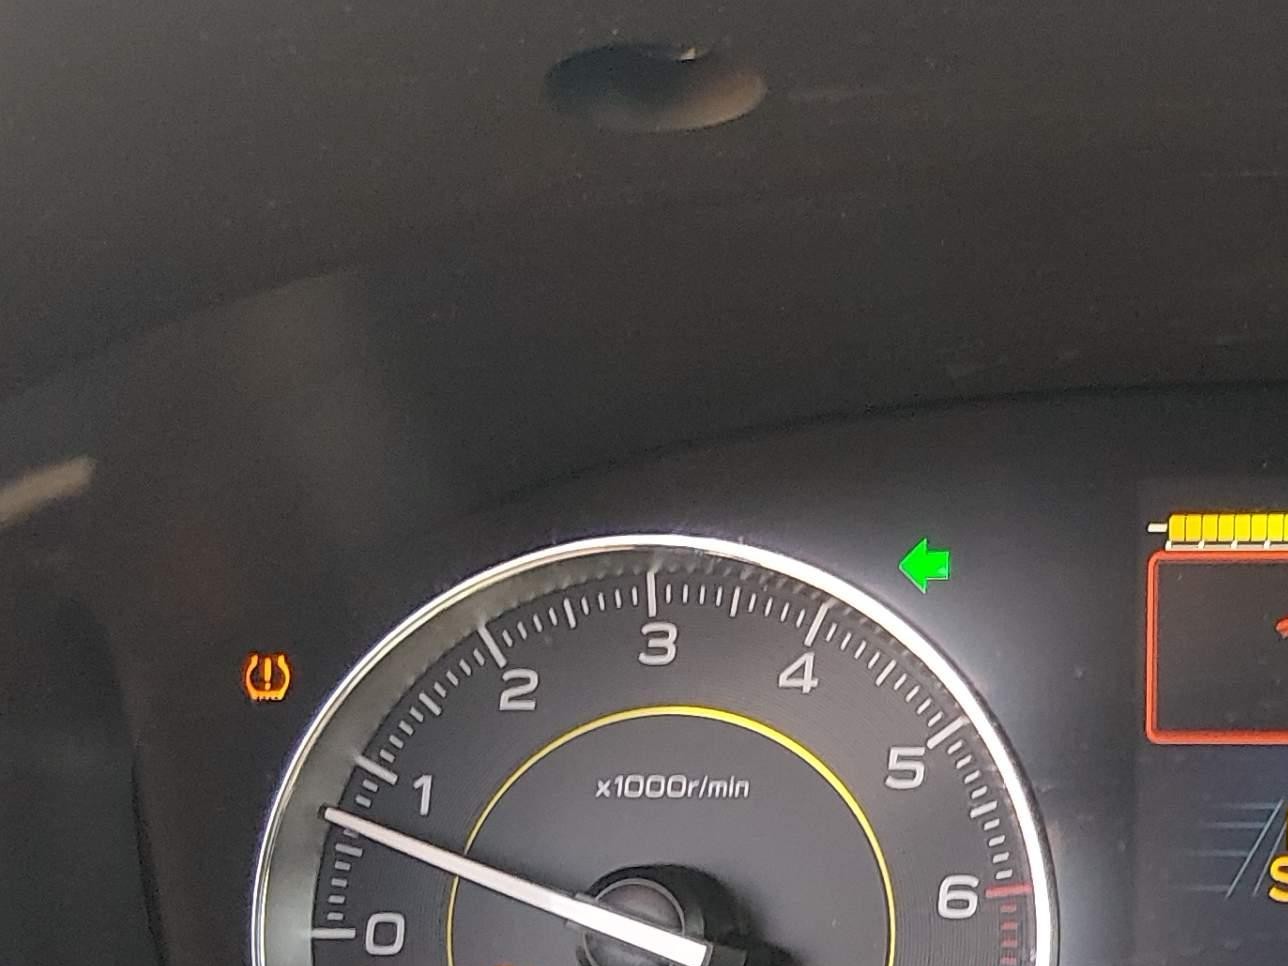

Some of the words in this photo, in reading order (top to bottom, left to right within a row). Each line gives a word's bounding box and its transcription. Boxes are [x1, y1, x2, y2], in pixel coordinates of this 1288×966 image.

[639, 622, 678, 665] 3
[498, 669, 539, 711] 2
[778, 653, 819, 694] 4
[595, 774, 750, 800] x1000r/min
[885, 746, 926, 789] 5
[412, 774, 432, 815] 1
[937, 875, 980, 919] 6
[365, 913, 405, 956] 0
